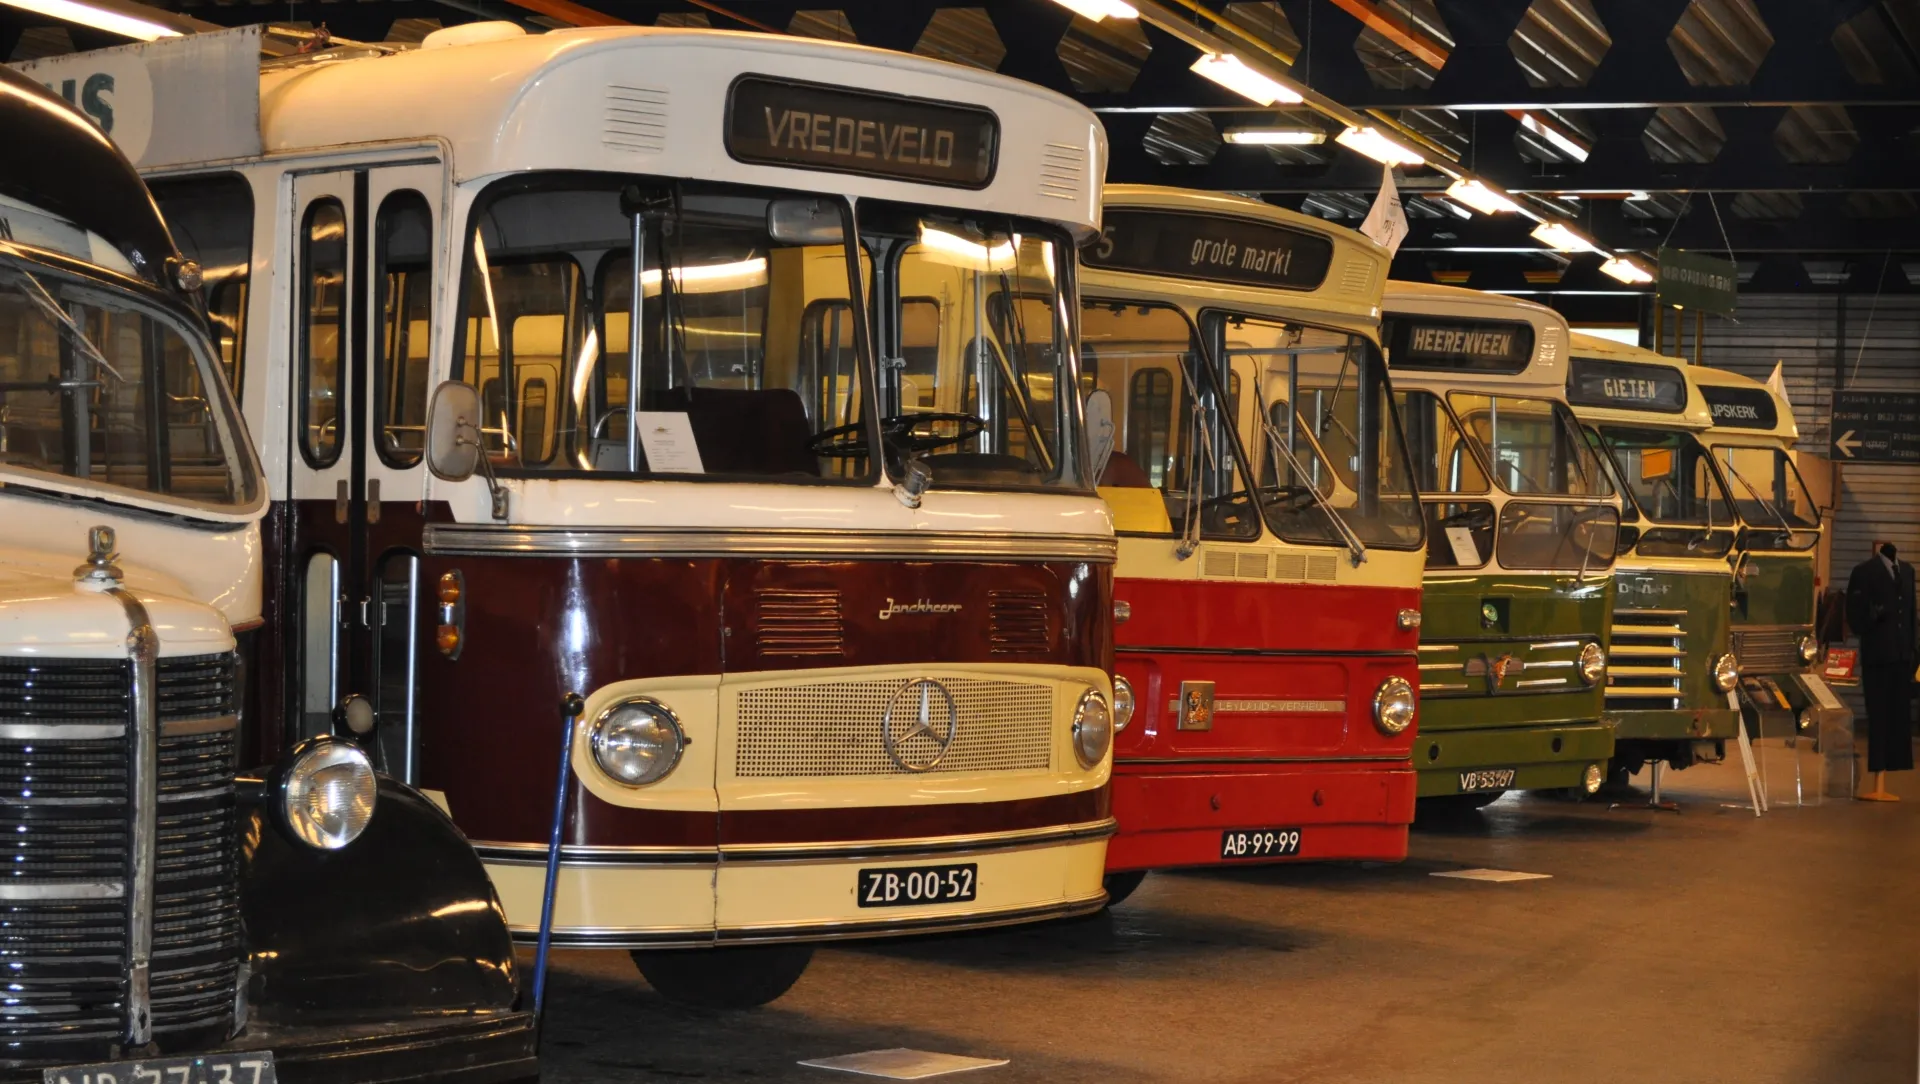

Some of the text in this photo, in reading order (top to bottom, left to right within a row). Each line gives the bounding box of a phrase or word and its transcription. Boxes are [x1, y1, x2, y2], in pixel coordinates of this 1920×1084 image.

[764, 106, 954, 168] VREDEVELD
[1190, 238, 1237, 265] grote
[1241, 247, 1292, 276] markt
[1413, 328, 1512, 356] HEERENVEEN
[1604, 378, 1656, 399] GIETEN
[1223, 831, 1299, 856] AB-99-99
[866, 868, 973, 902] ZB-00-52
